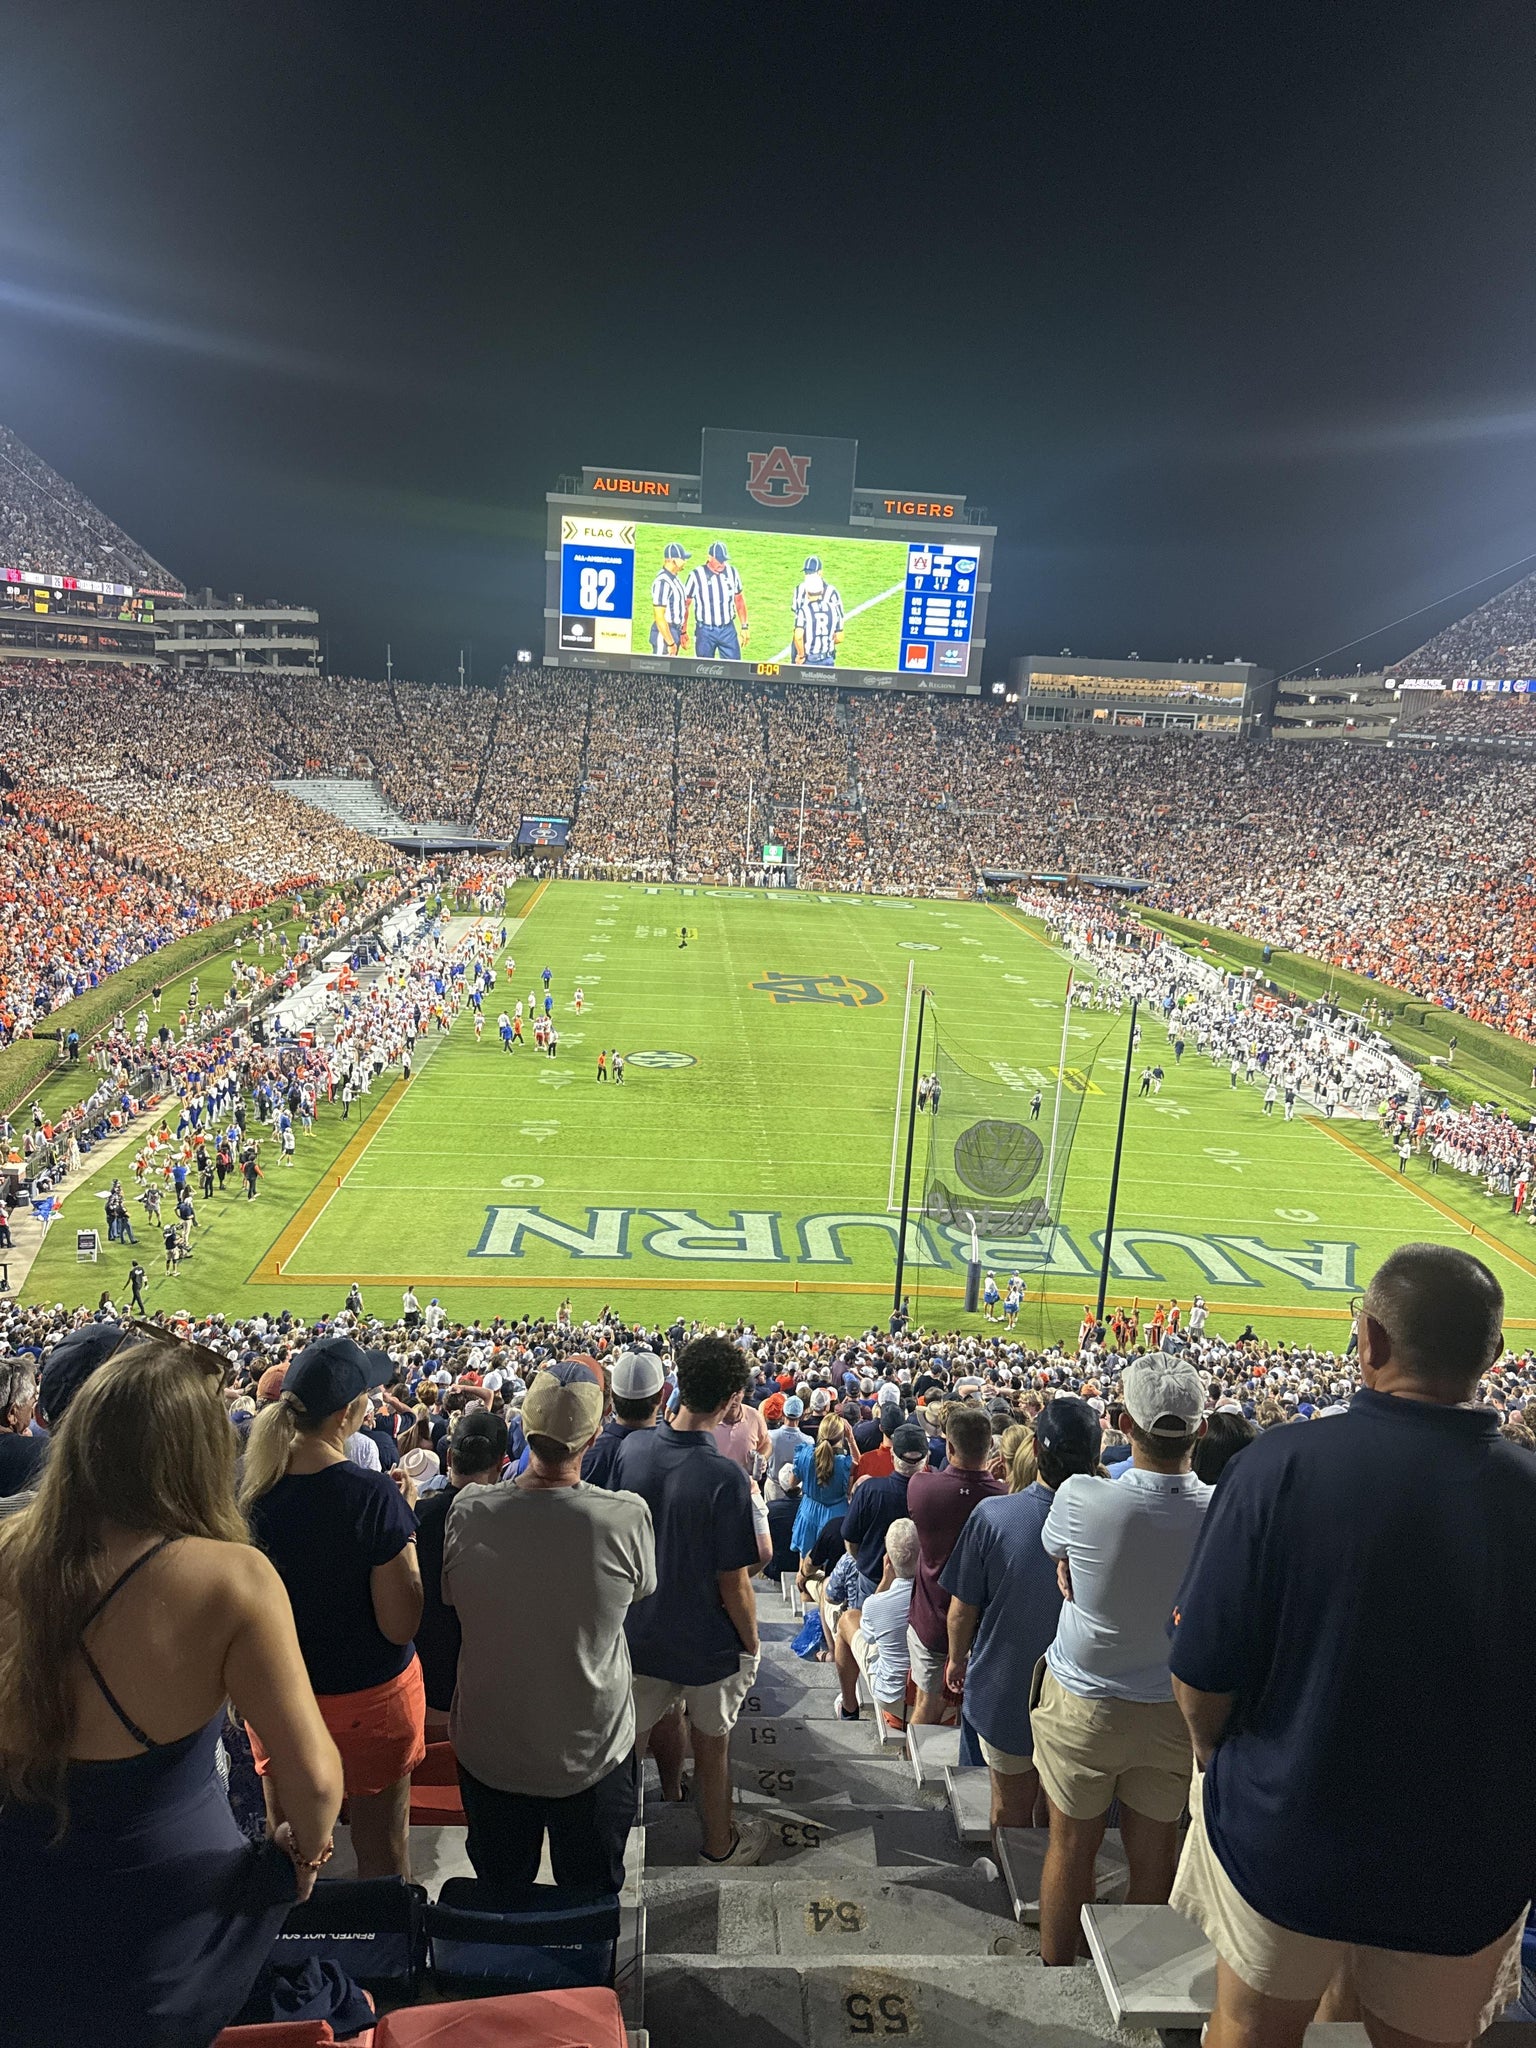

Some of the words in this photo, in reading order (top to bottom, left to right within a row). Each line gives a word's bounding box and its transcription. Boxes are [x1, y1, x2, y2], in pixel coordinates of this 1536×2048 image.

[592, 477, 670, 496] AUBURN
[883, 499, 955, 518] TIGERS
[584, 527, 614, 538] FLAG
[579, 567, 616, 612] 82
[757, 663, 780, 676] 0:09
[629, 886, 917, 909] TIGERS
[500, 1174, 545, 1188] G
[1274, 1208, 1320, 1223] G
[467, 1205, 1366, 1292] AUBURN
[750, 1727, 777, 1745] 51
[758, 1769, 796, 1791] 52
[780, 1823, 820, 1849] 53
[808, 1901, 861, 1933] 54
[845, 1993, 910, 2034] 55
